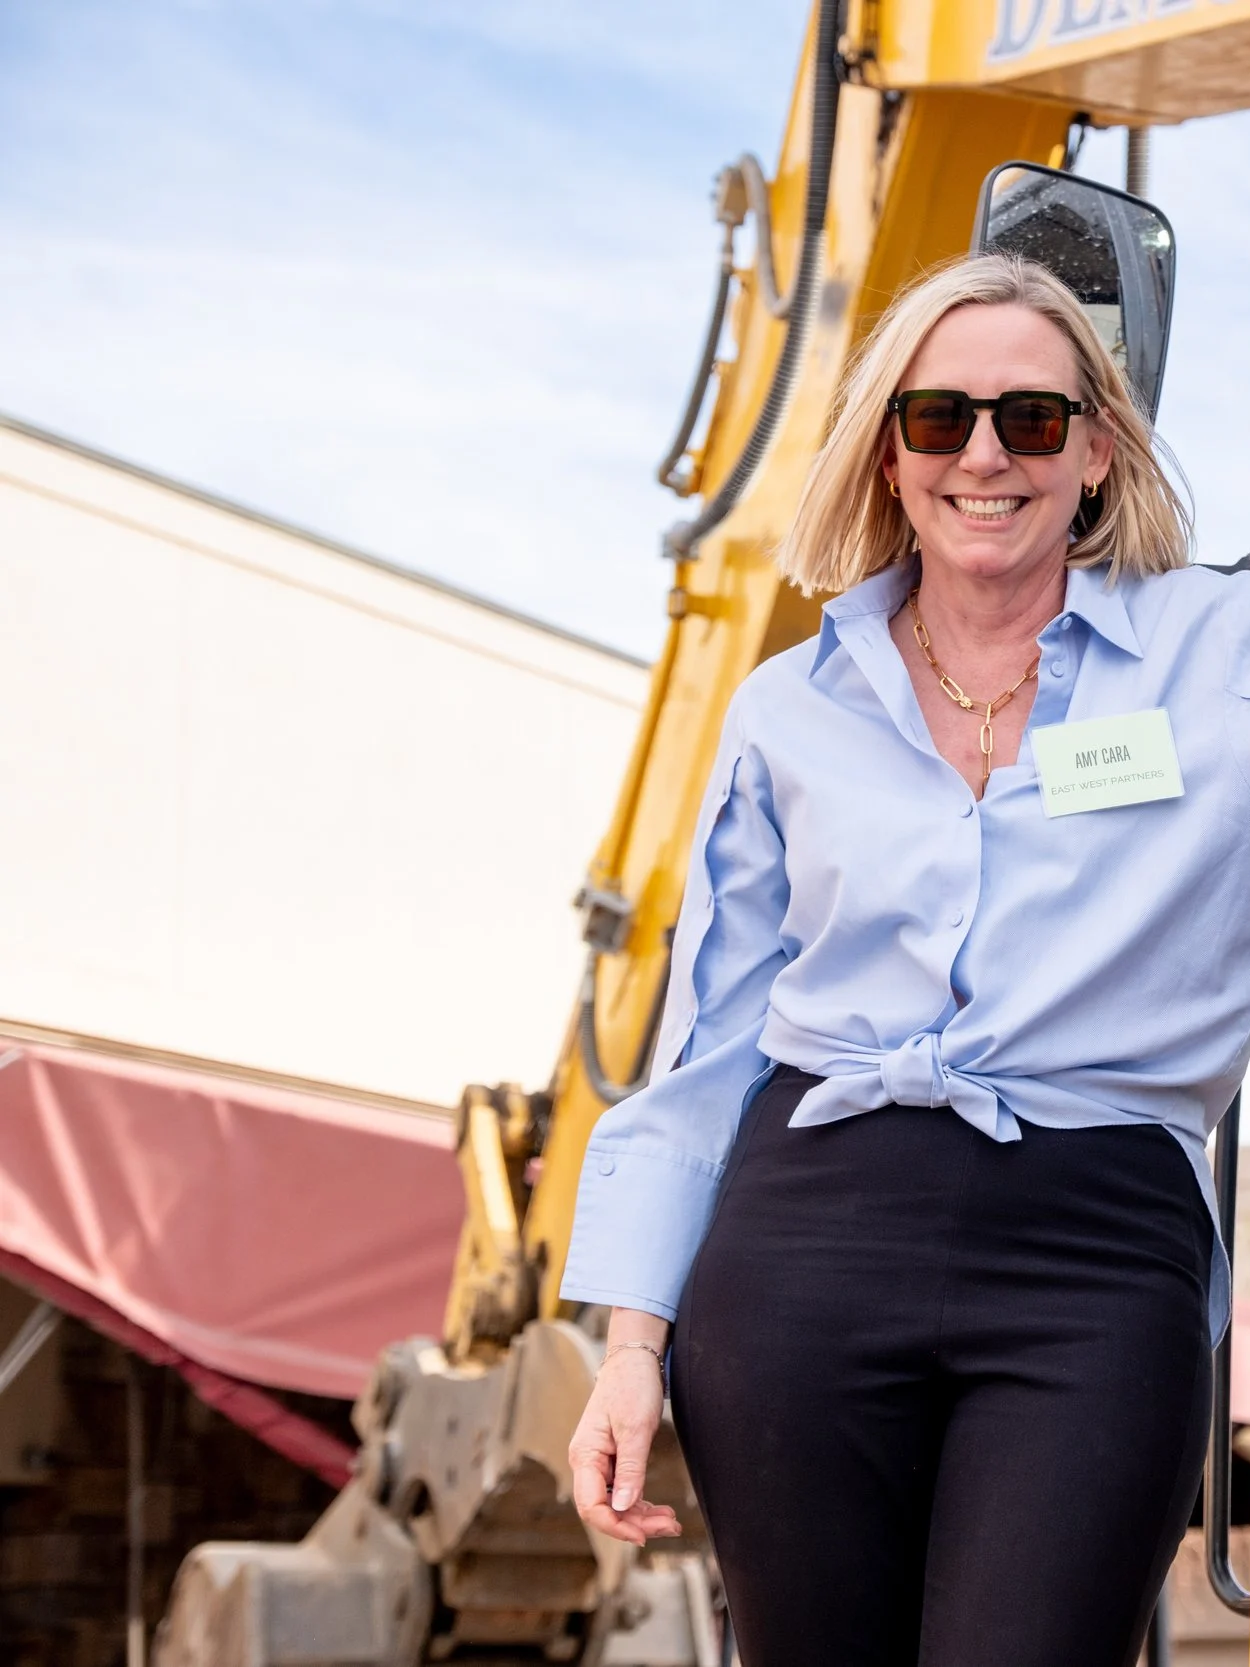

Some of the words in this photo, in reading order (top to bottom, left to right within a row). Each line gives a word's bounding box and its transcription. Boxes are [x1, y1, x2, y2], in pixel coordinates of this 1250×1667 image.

[1075, 750, 1098, 769] AMY
[1101, 745, 1131, 765] CARA
[1051, 783, 1076, 796] EAST
[1079, 778, 1109, 790] WEST
[1111, 770, 1165, 785] PARTNERS
